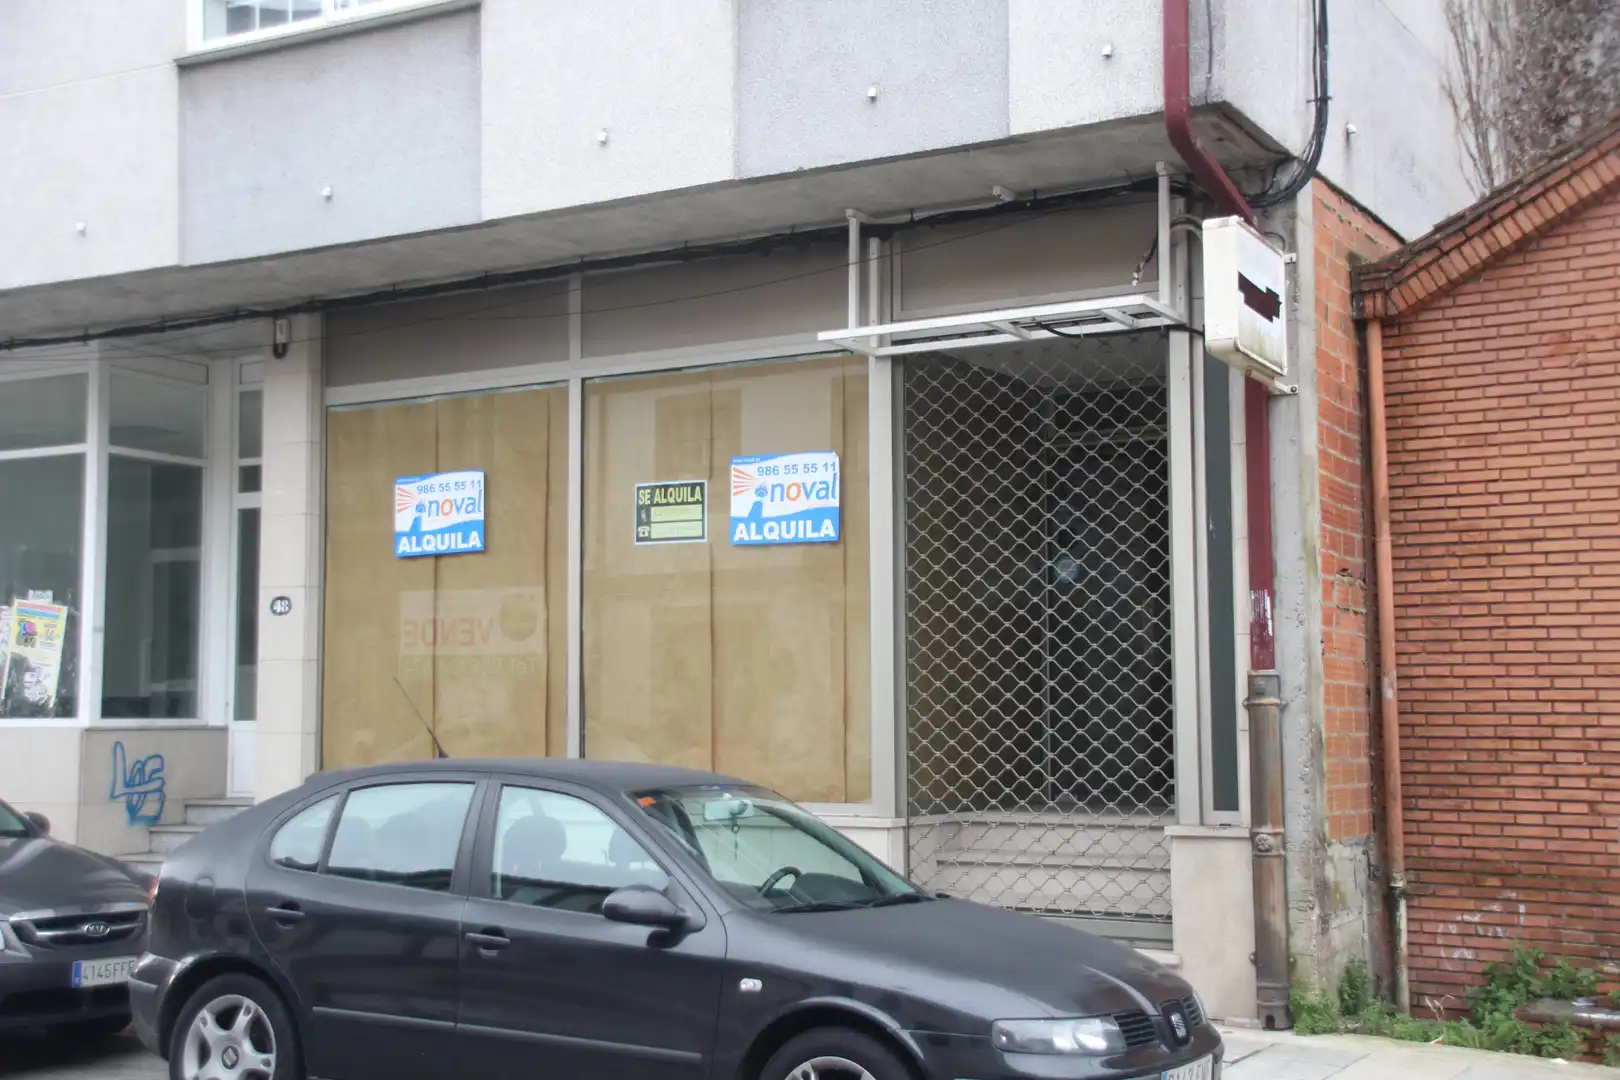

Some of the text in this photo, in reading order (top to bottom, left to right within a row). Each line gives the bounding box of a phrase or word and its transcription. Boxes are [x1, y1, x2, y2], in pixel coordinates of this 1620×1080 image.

[757, 462, 837, 476] 986 55 55 11
[416, 480, 482, 494] 986 55 55 11
[639, 486, 702, 505] SE ALQUILA
[733, 518, 836, 541] ALQUILA
[398, 531, 482, 553] ALQUILA
[273, 599, 289, 613] 48
